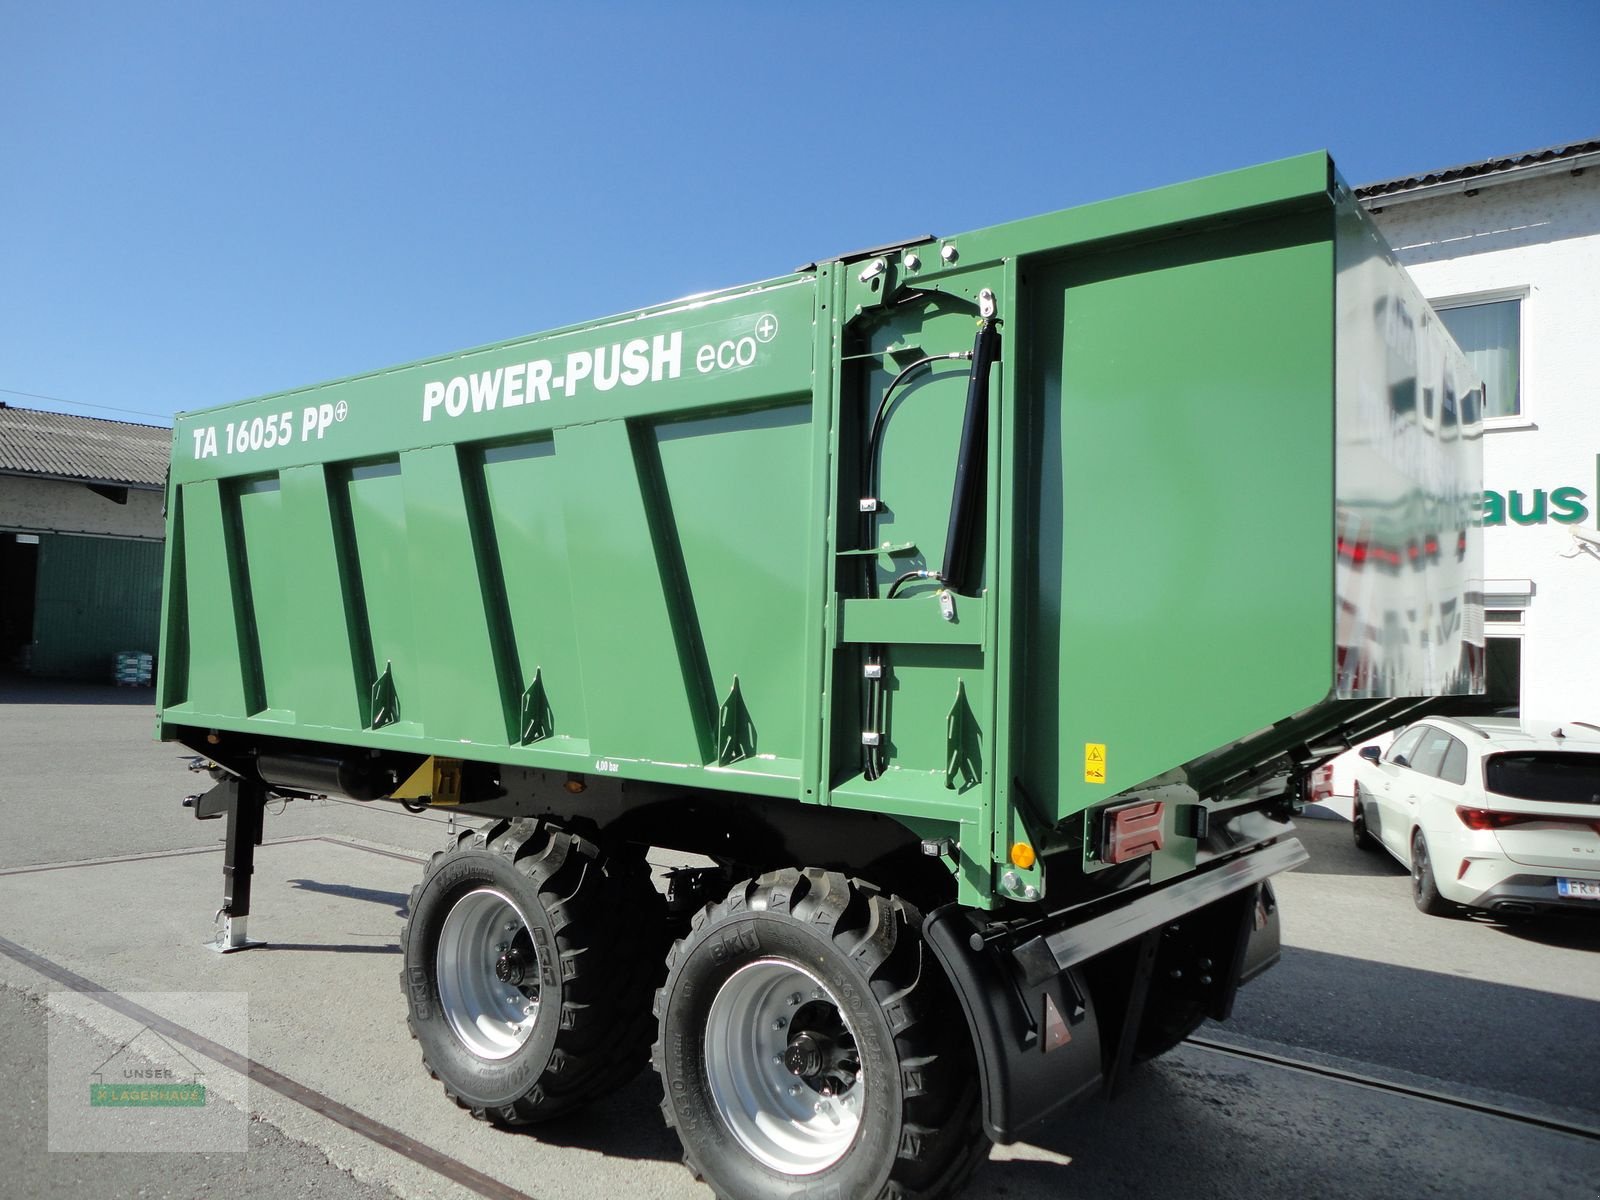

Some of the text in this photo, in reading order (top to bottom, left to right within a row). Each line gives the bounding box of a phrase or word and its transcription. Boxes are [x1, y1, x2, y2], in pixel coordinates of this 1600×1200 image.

[422, 331, 757, 423] POWER-PUSH eco
[193, 426, 217, 460] TA
[226, 411, 293, 454] 16055
[608, 761, 619, 772] bar
[1570, 881, 1588, 895] FR
[709, 920, 760, 966] BKT
